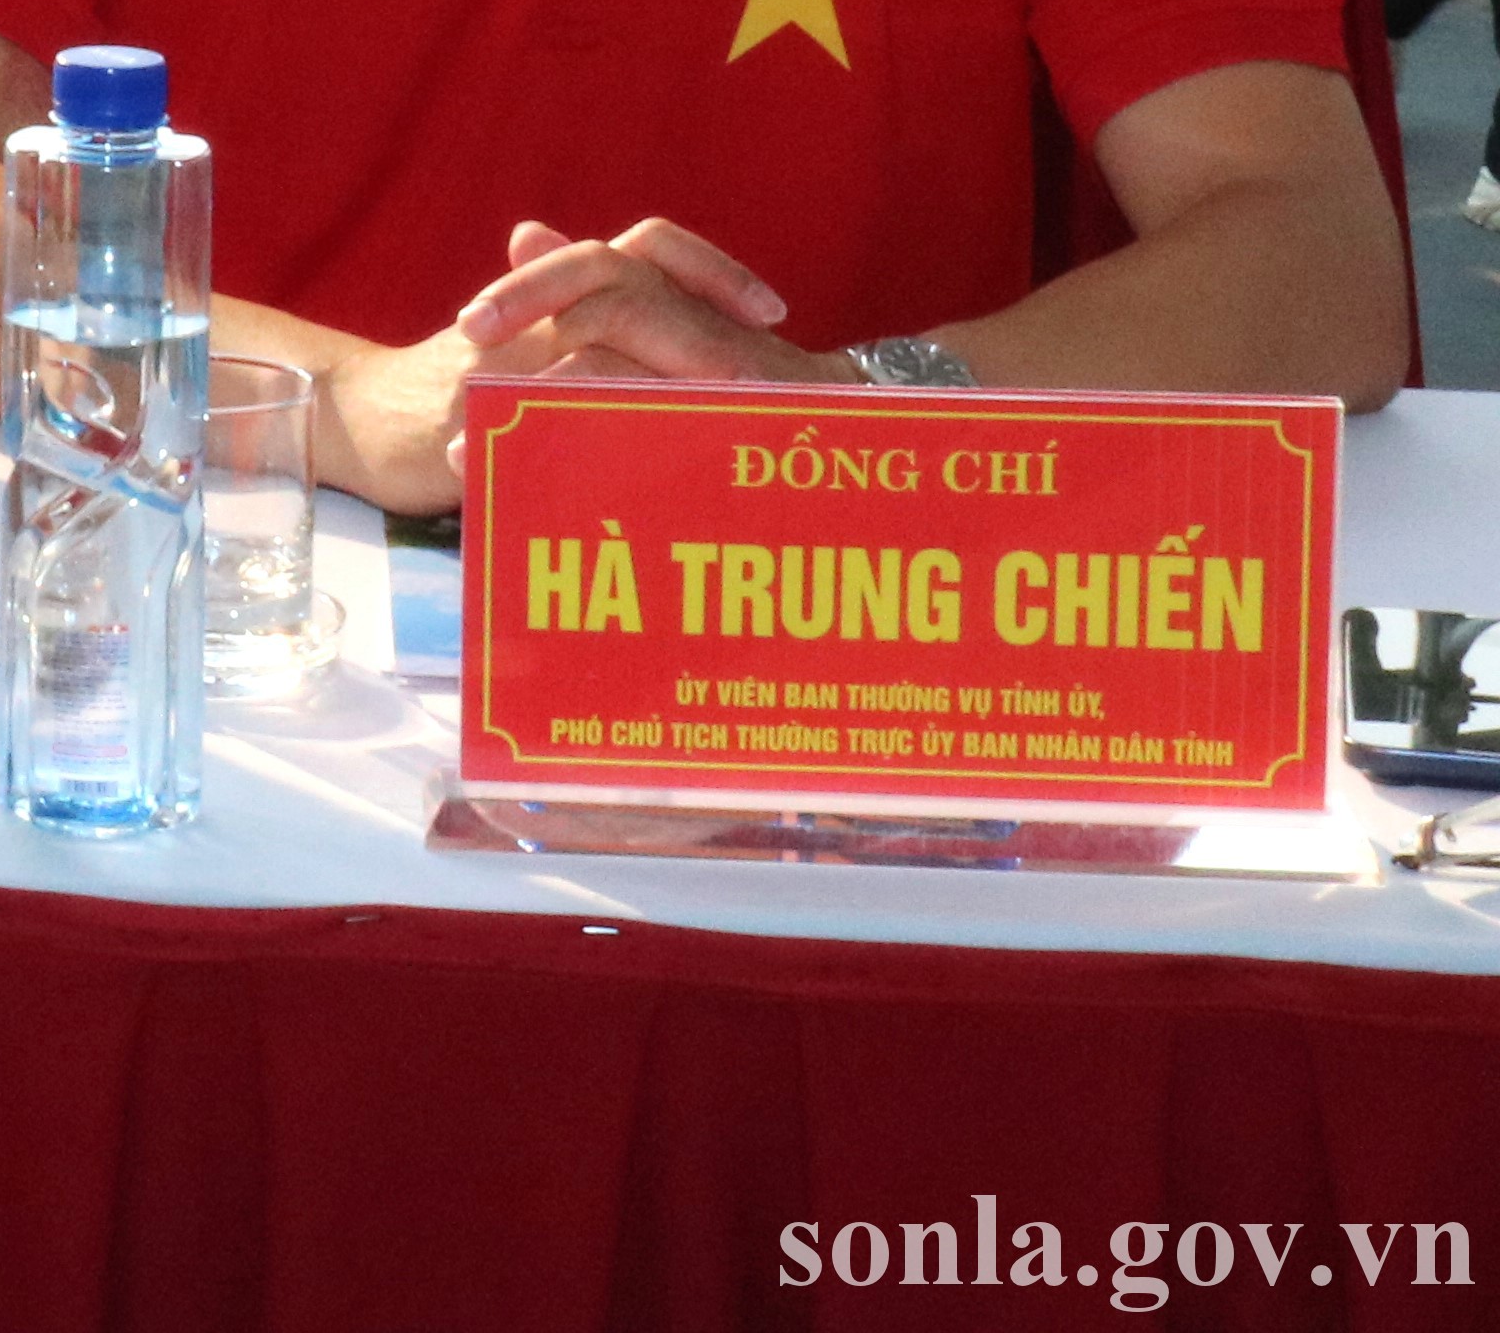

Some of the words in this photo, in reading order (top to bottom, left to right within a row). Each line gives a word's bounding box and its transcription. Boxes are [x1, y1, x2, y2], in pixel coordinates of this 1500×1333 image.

[731, 425, 921, 493] ĐỒNG
[942, 439, 1057, 496] CHÍ
[526, 518, 643, 634] HÀ
[670, 541, 963, 644] TRUNG
[993, 523, 1265, 653] CHIẾN
[675, 671, 710, 706] ỦY
[717, 675, 777, 708] VIÊN
[783, 683, 839, 710] BAN
[958, 687, 993, 720] VỤ
[999, 681, 1061, 717] TỈNH
[1067, 683, 1106, 721] ỦY,
[550, 714, 604, 747] PHÓ
[610, 714, 664, 748] CHỦ
[670, 722, 729, 755] TỊCH
[846, 727, 914, 760] TRỰC
[921, 722, 956, 757] ỦY
[962, 731, 1019, 759] BAN
[1025, 729, 1103, 763] NHÂN
[1108, 731, 1165, 765] DÂN
[1171, 731, 1234, 767] TỈNH
